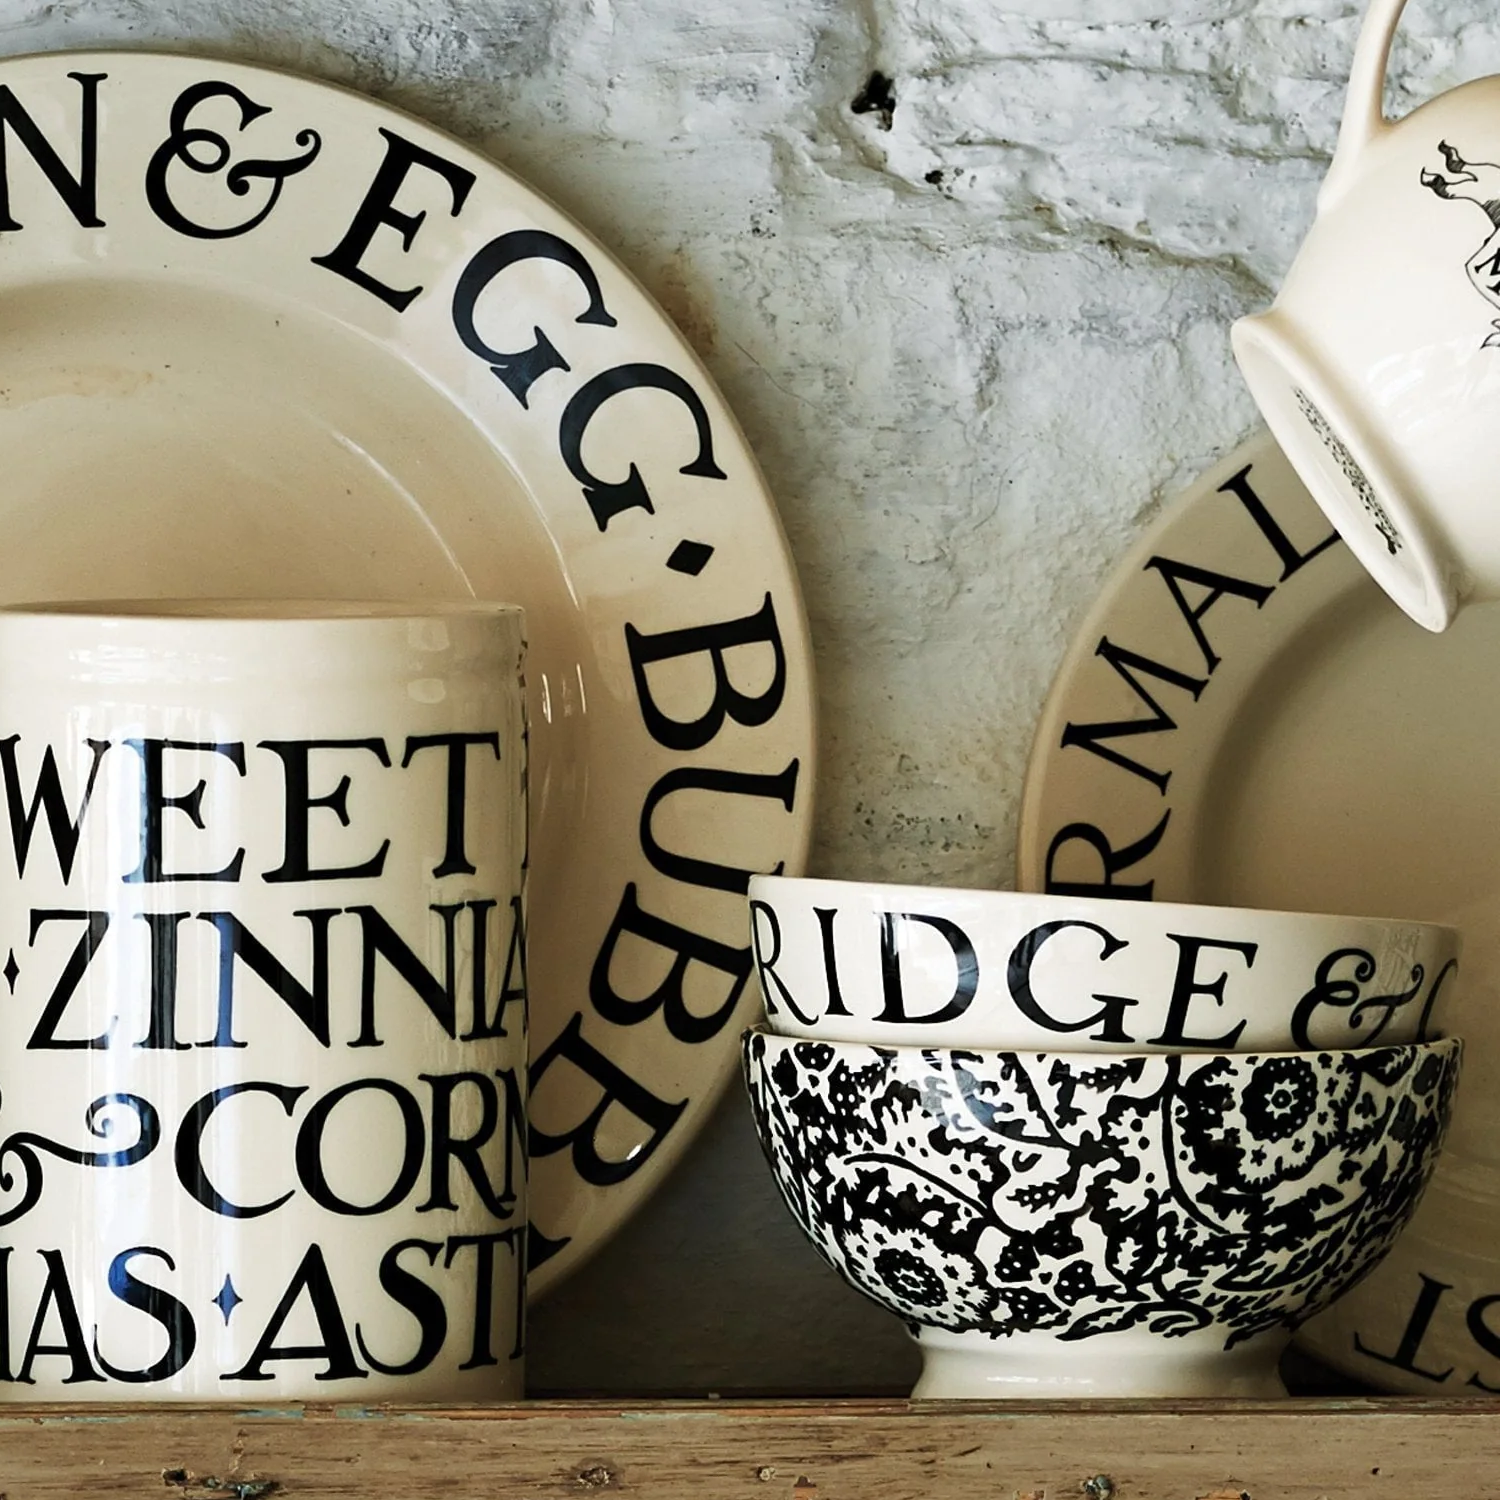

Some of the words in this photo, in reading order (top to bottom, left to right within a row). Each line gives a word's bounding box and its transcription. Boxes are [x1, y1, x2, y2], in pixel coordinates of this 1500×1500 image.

[145, 80, 321, 240] &
[312, 127, 728, 532] EGG
[528, 591, 802, 1273] BUBB
[750, 899, 1258, 1050] RIDGE
[1291, 948, 1424, 1050] &
[220, 1228, 525, 1381] AST
